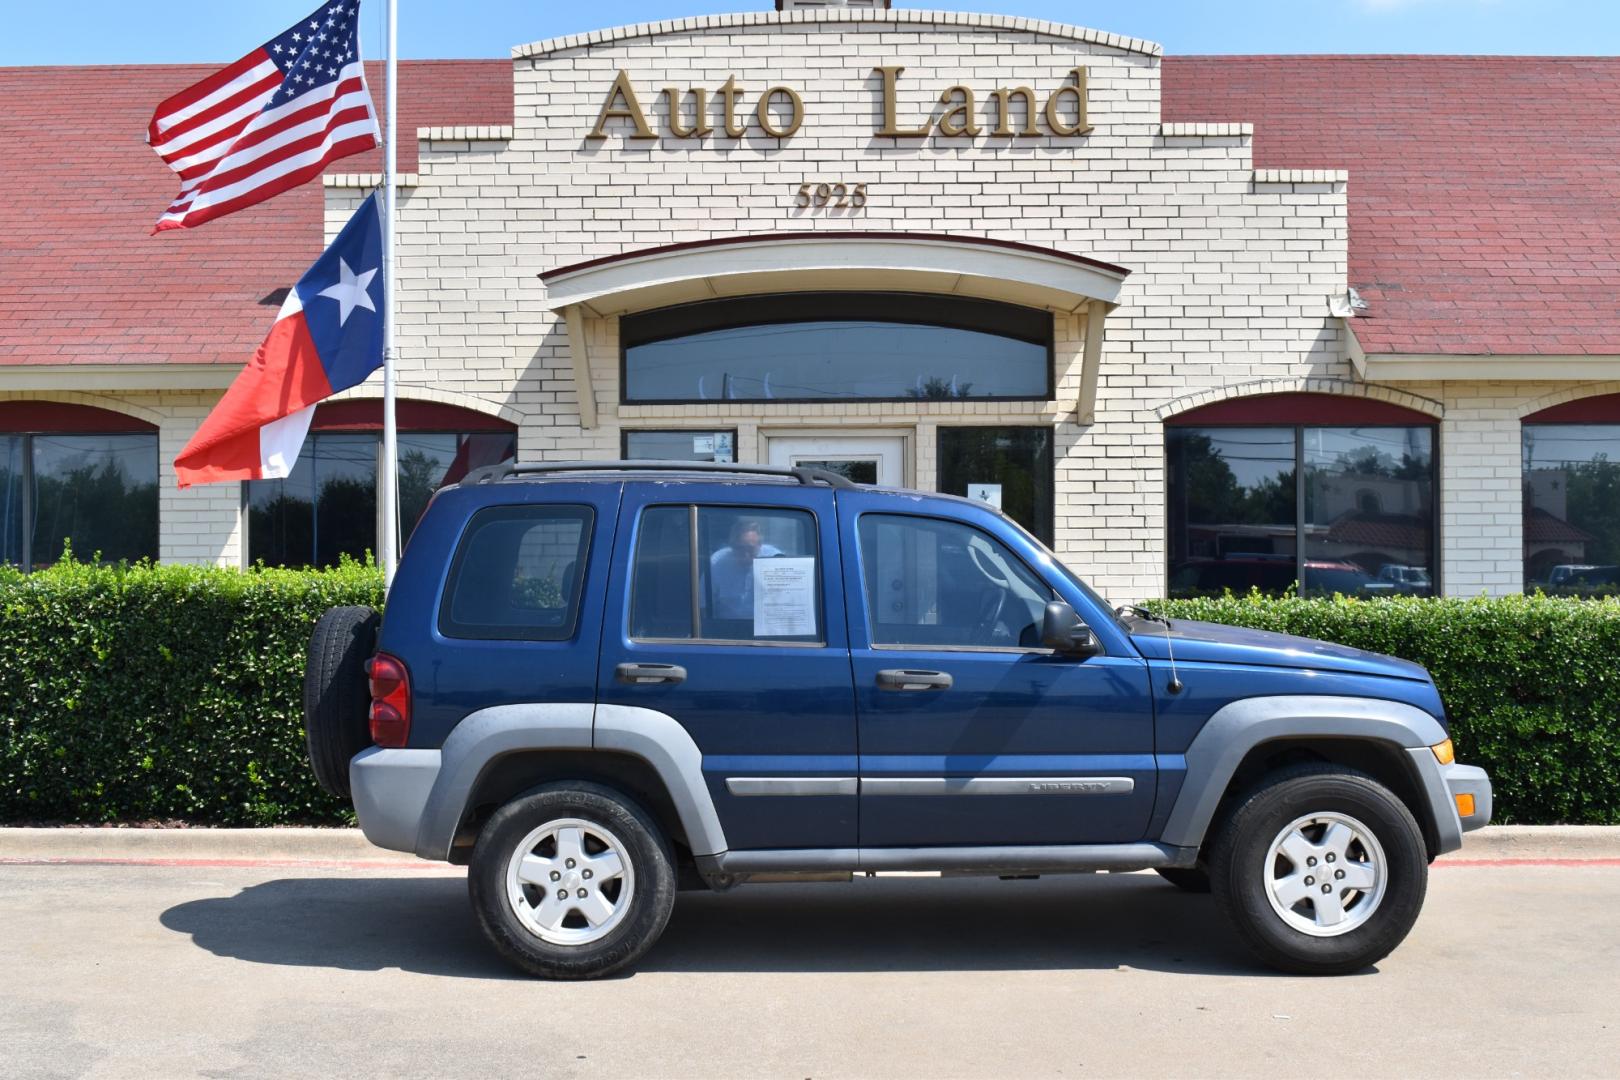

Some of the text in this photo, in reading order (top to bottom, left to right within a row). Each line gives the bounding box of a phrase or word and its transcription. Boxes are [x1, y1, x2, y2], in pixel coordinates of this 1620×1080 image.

[586, 65, 1095, 140] Auto Land
[798, 182, 867, 209] 5925
